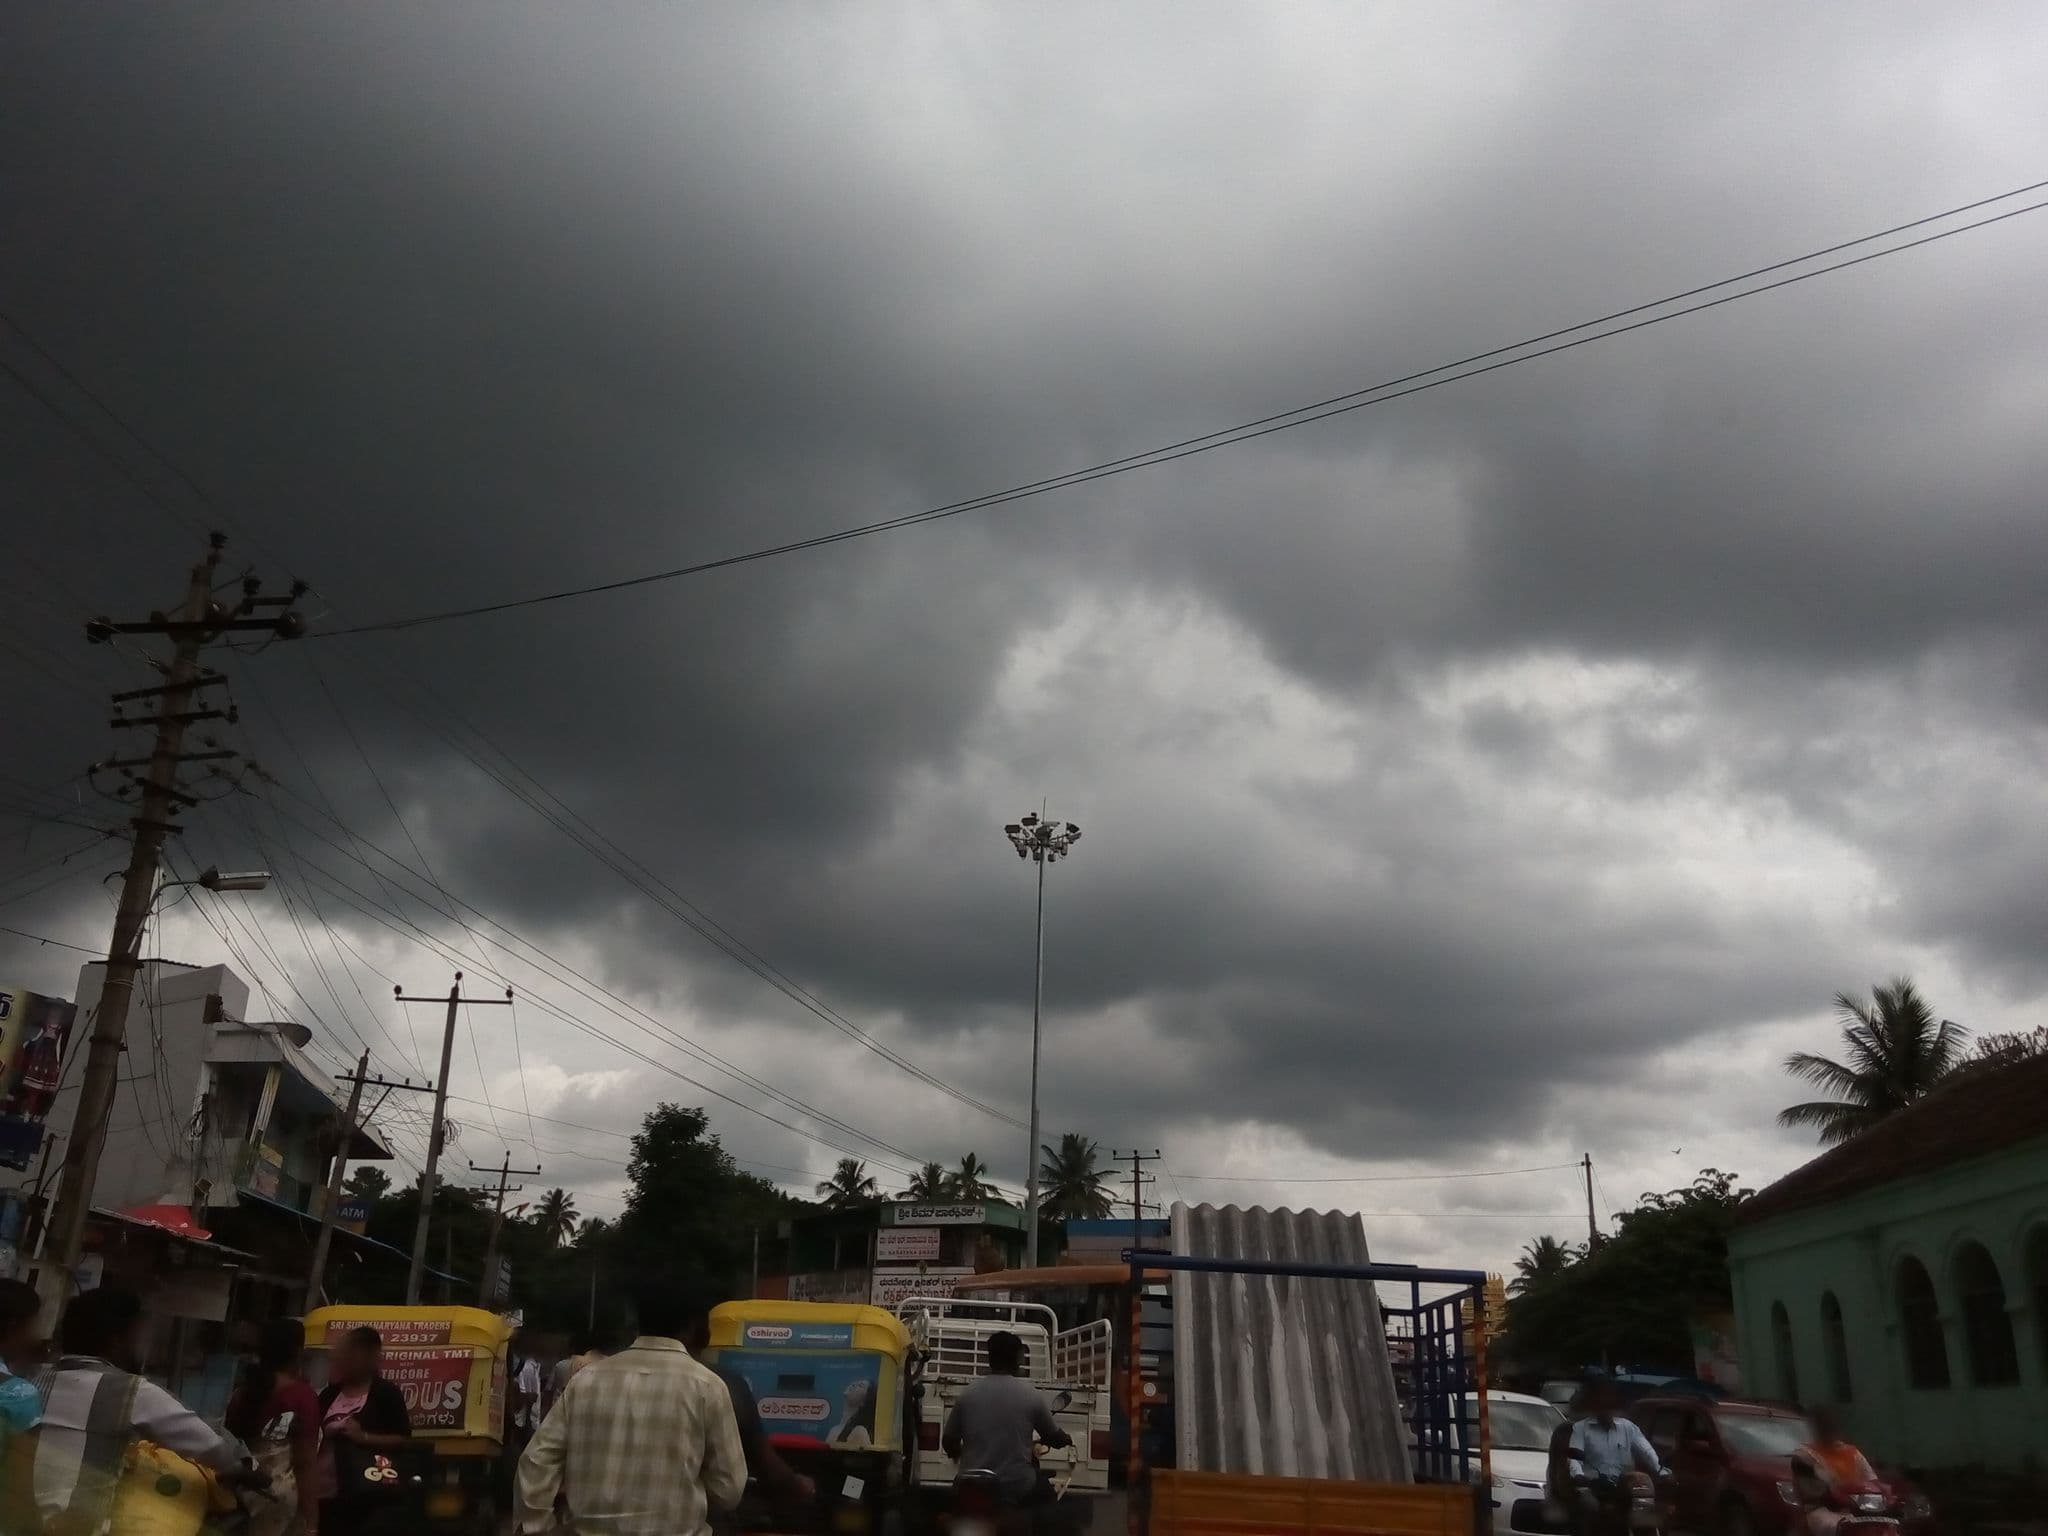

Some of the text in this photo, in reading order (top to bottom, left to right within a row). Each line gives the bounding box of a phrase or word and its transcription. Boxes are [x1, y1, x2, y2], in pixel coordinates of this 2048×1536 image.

[340, 1207, 364, 1218] ATM
[330, 1321, 344, 1330] SRI
[413, 1321, 451, 1330] TRADERS
[390, 1333, 438, 1343] 23937
[750, 1328, 790, 1338] ashirvad
[443, 1349, 472, 1359] TMT
